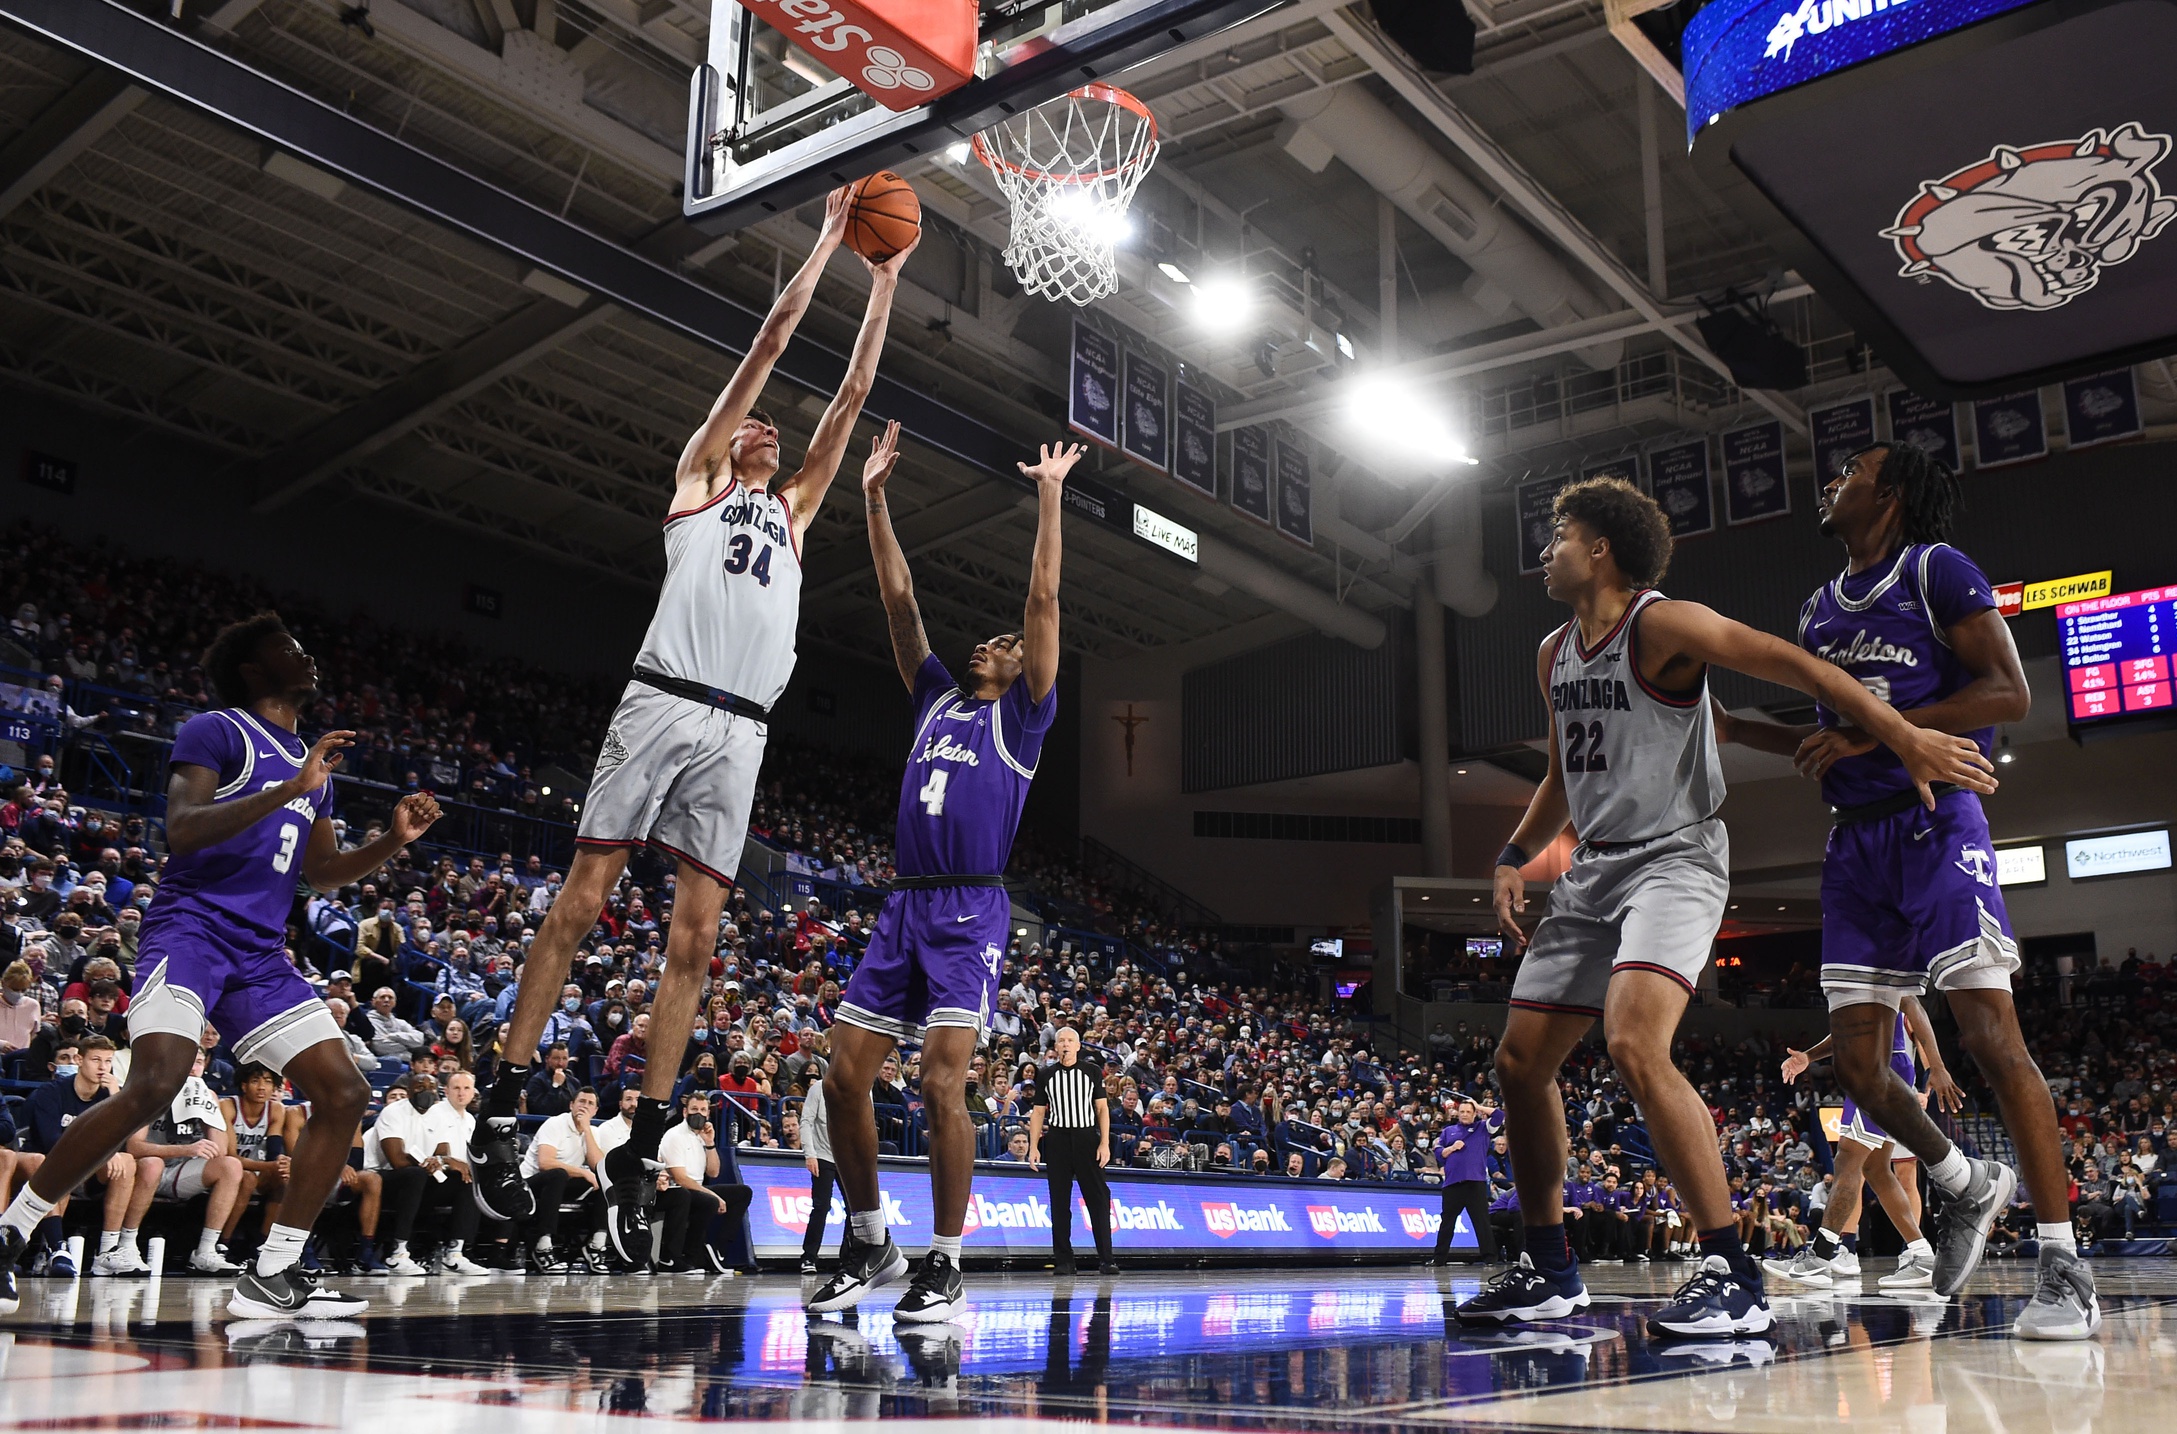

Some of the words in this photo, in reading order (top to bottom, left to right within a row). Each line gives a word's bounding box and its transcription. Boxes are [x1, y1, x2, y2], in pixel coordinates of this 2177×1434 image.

[757, 0, 873, 51] Sta
[1906, 400, 1937, 414] NCAA
[1828, 420, 1858, 434] NCAA
[1739, 442, 1767, 455] NCAA
[38, 462, 67, 484] 114
[1665, 462, 1692, 474] NCAA
[1675, 470, 1703, 482] Round
[1064, 490, 1106, 519] 3-POINTERS
[1533, 497, 1554, 507] NCA
[720, 502, 786, 547] GONZGA
[724, 533, 772, 588] 34
[1992, 588, 2021, 608] ires
[2026, 588, 2046, 603] LES
[2050, 578, 2107, 599] SCHWAB
[476, 593, 496, 611] 115
[2065, 605, 2080, 615] ON
[2080, 601, 2099, 612] THE
[2100, 596, 2131, 609] FLOOR
[2141, 591, 2160, 602] PTS
[2164, 587, 2177, 598] RE
[2067, 627, 2075, 636] 3
[2066, 636, 2079, 646] 22
[2067, 646, 2080, 656] 34
[2068, 656, 2081, 666] 45
[2085, 666, 2100, 677] FG
[2133, 658, 2154, 670] 3FG
[2082, 677, 2105, 688] 41%
[2133, 670, 2157, 681] 14%
[1551, 678, 1632, 712] GONZAGA
[2084, 691, 2106, 703] REB
[2136, 684, 2156, 696] AST
[2089, 703, 2105, 713] 31
[2143, 696, 2152, 706] 3
[9, 725, 31, 740] 113
[1566, 720, 1608, 773] 22
[919, 768, 949, 817] 4
[271, 822, 299, 875] 3
[2094, 846, 2162, 862] Northwest
[797, 884, 810, 894] 115
